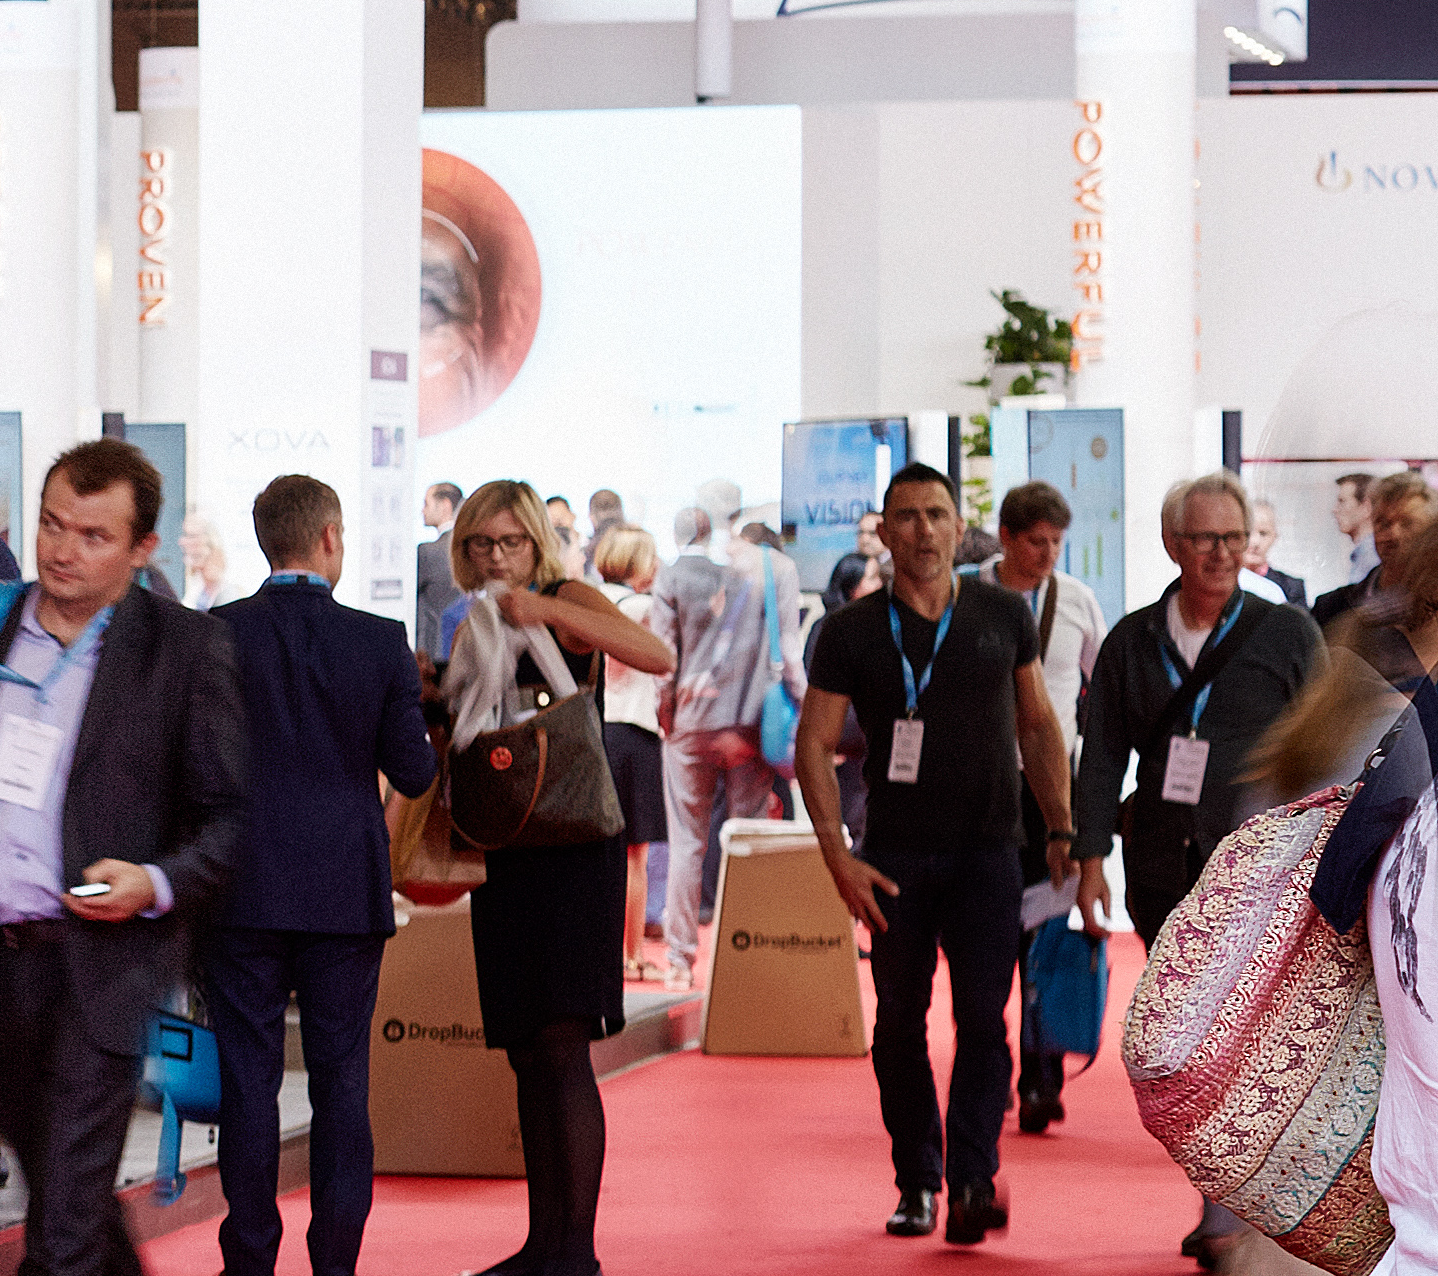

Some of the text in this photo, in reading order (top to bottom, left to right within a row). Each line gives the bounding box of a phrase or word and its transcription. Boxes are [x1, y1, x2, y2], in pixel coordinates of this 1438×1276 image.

[138, 148, 166, 326] PROVEN
[1070, 99, 1103, 372] POWERFUL
[753, 931, 841, 950] DropBucket
[408, 1022, 484, 1044] DropBuc
